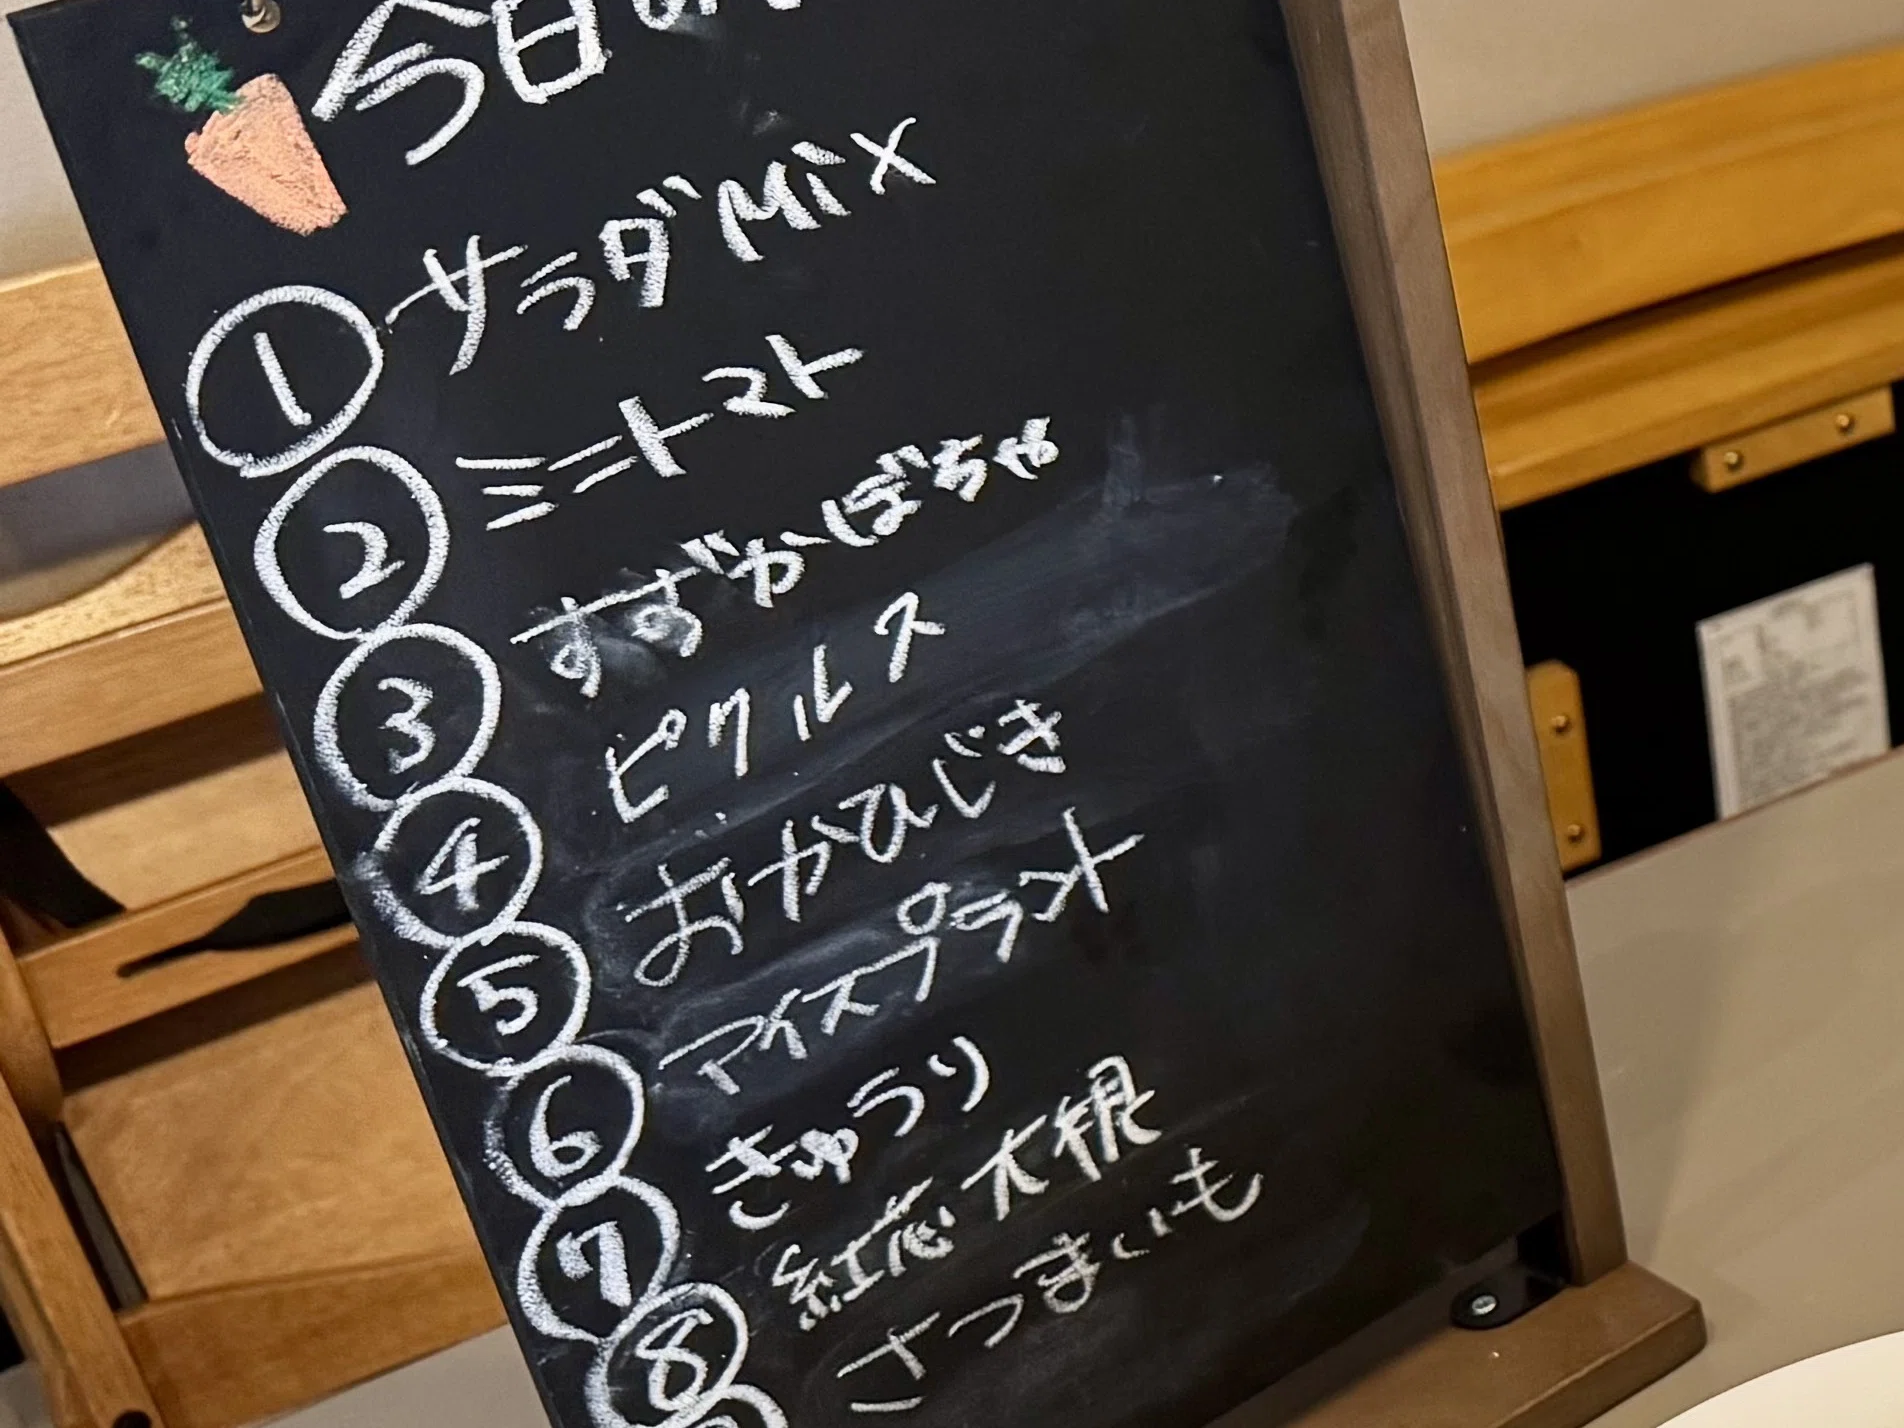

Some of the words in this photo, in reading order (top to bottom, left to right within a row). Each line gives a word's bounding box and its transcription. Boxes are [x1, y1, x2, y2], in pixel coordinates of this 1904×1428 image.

[455, 334, 865, 530] ミニトマト
[606, 592, 945, 823] ピクルス
[625, 699, 1066, 986] おかひじき
[658, 807, 1144, 1095] アイスプラント
[705, 1036, 990, 1230] きゅうり
[771, 1055, 1162, 1331] 紅芯大根
[837, 1148, 1264, 1411] さつまいも
